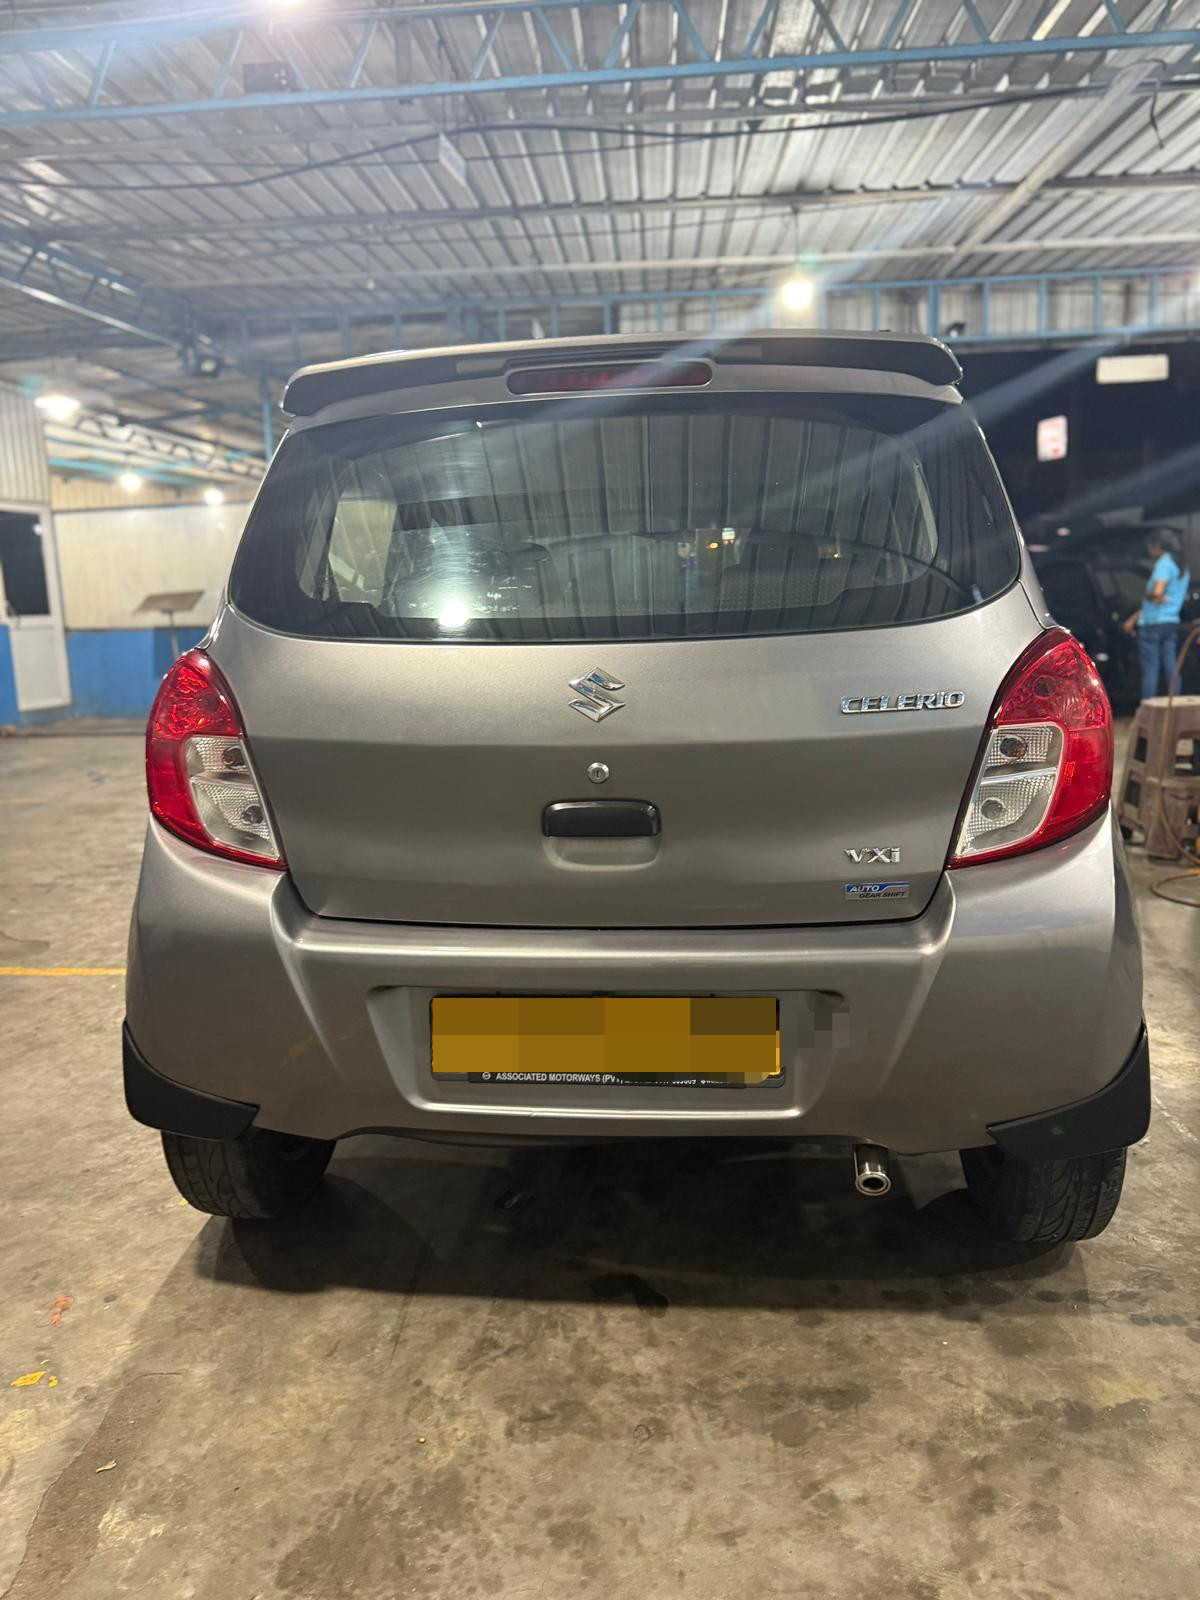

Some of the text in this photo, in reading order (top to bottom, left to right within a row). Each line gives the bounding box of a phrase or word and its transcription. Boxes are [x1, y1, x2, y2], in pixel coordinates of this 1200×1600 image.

[849, 884, 881, 893] AUTO
[859, 891, 881, 899] GEAR
[495, 1072, 547, 1081] ASSOCIATED
[548, 1073, 601, 1083] MOTORWAYS
